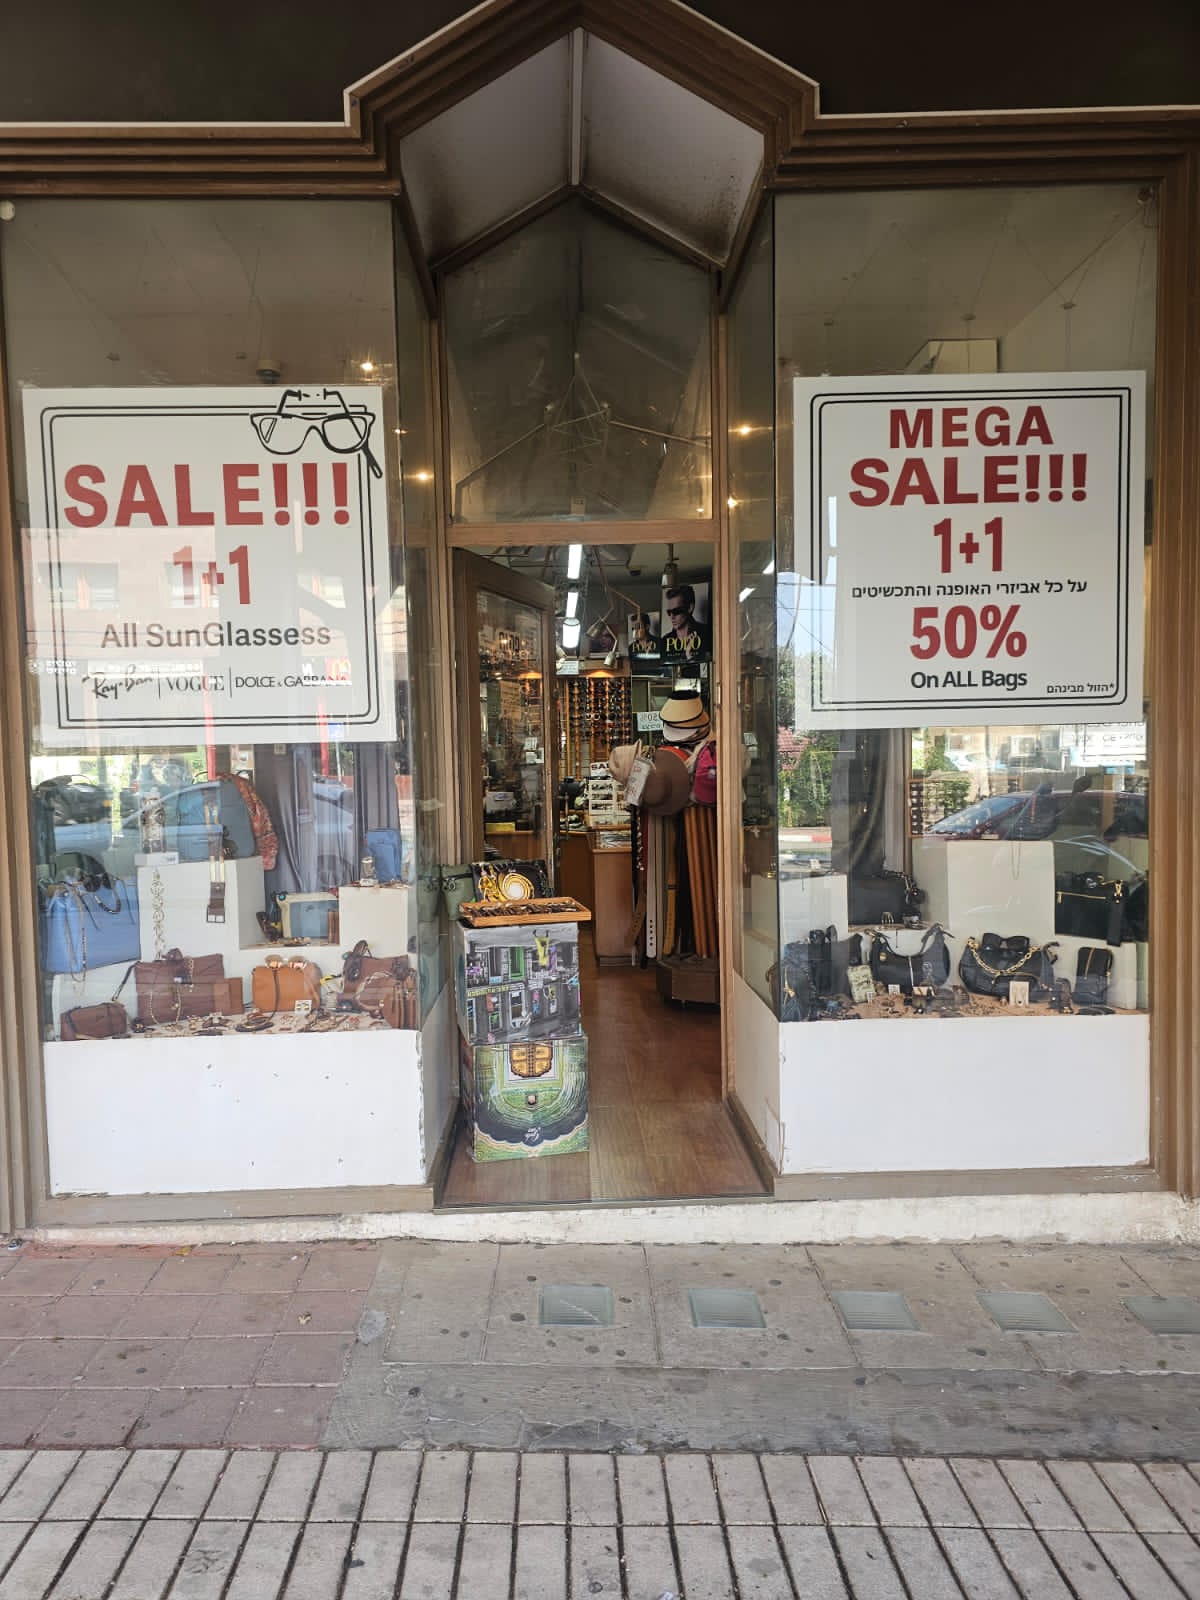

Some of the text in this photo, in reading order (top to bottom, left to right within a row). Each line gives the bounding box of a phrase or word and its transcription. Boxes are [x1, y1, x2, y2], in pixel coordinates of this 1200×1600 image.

[889, 405, 1054, 449] MEGA
[63, 462, 350, 528] SALE!!!
[848, 453, 1088, 507] SALE!!!
[933, 516, 1003, 574] 1+1
[172, 544, 251, 605] 1+1
[851, 579, 1087, 599] על כל אביזרי האופנה והתכשיטים
[101, 620, 331, 649] All SunGlassess
[909, 604, 1028, 660] 50%
[165, 675, 225, 692] VOGUE
[235, 675, 276, 688] DOLCE
[910, 669, 1028, 691] On ALL Bags
